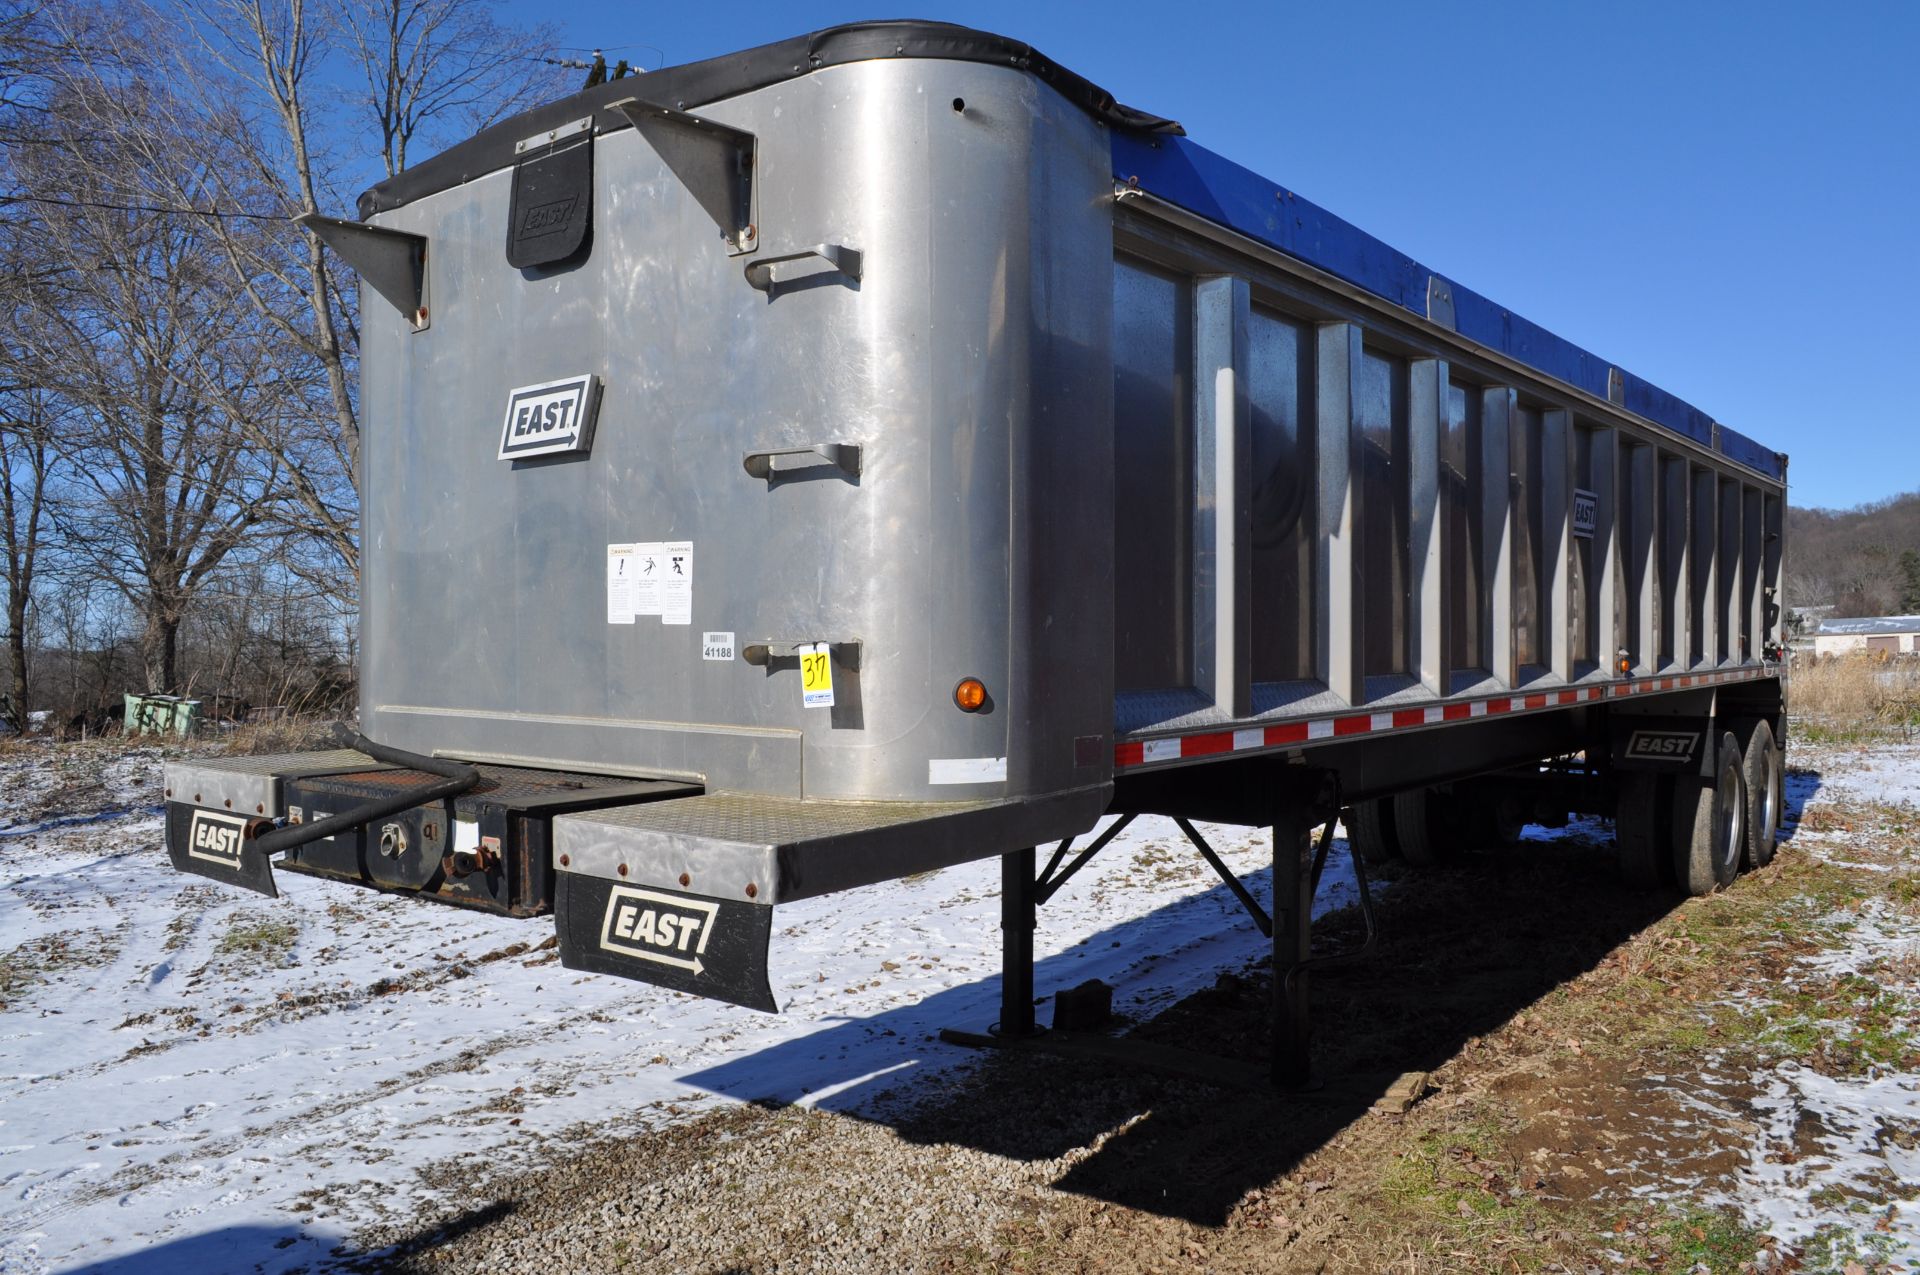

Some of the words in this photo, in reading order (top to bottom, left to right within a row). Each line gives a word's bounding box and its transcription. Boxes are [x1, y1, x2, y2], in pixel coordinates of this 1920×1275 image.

[514, 398, 575, 437] EAST
[1575, 503, 1594, 525] EAST
[704, 646, 732, 658] 41188
[804, 655, 825, 687] 37
[1635, 738, 1691, 754] EAST
[195, 822, 239, 854] EAST
[615, 905, 701, 951] EAST
